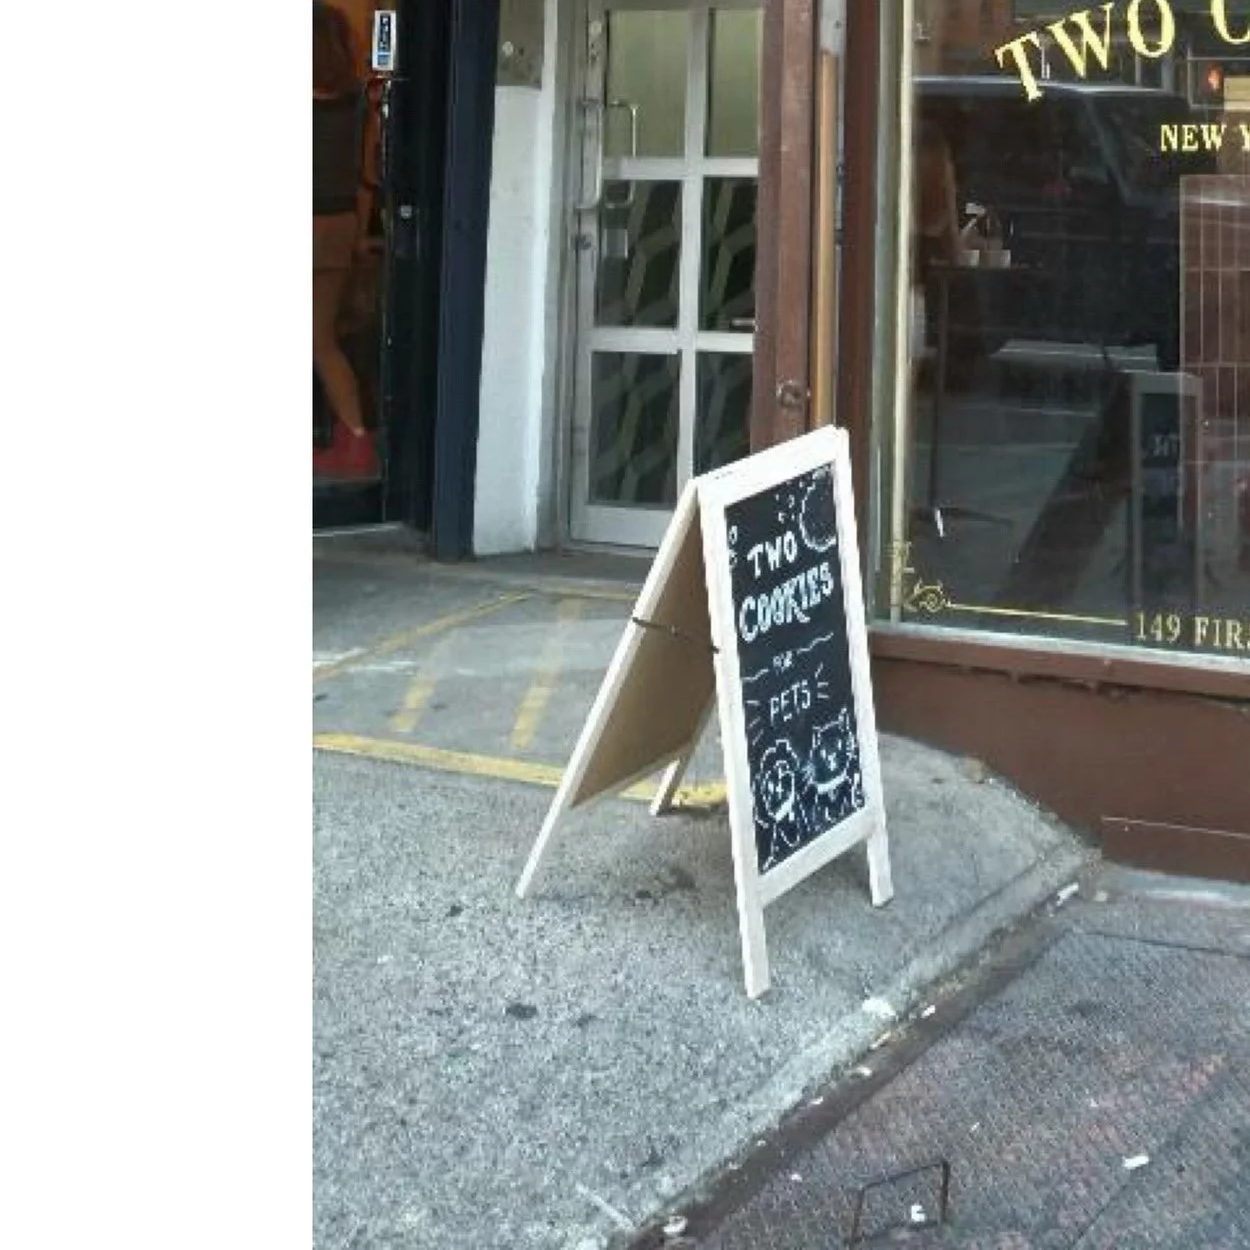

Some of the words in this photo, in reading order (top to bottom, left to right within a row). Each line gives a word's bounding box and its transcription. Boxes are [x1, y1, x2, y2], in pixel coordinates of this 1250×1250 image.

[1160, 123, 1226, 152] NEW
[746, 530, 798, 579] TWO
[738, 561, 835, 643] COOKIES
[1134, 610, 1182, 642] 149
[770, 679, 812, 726] PETS
